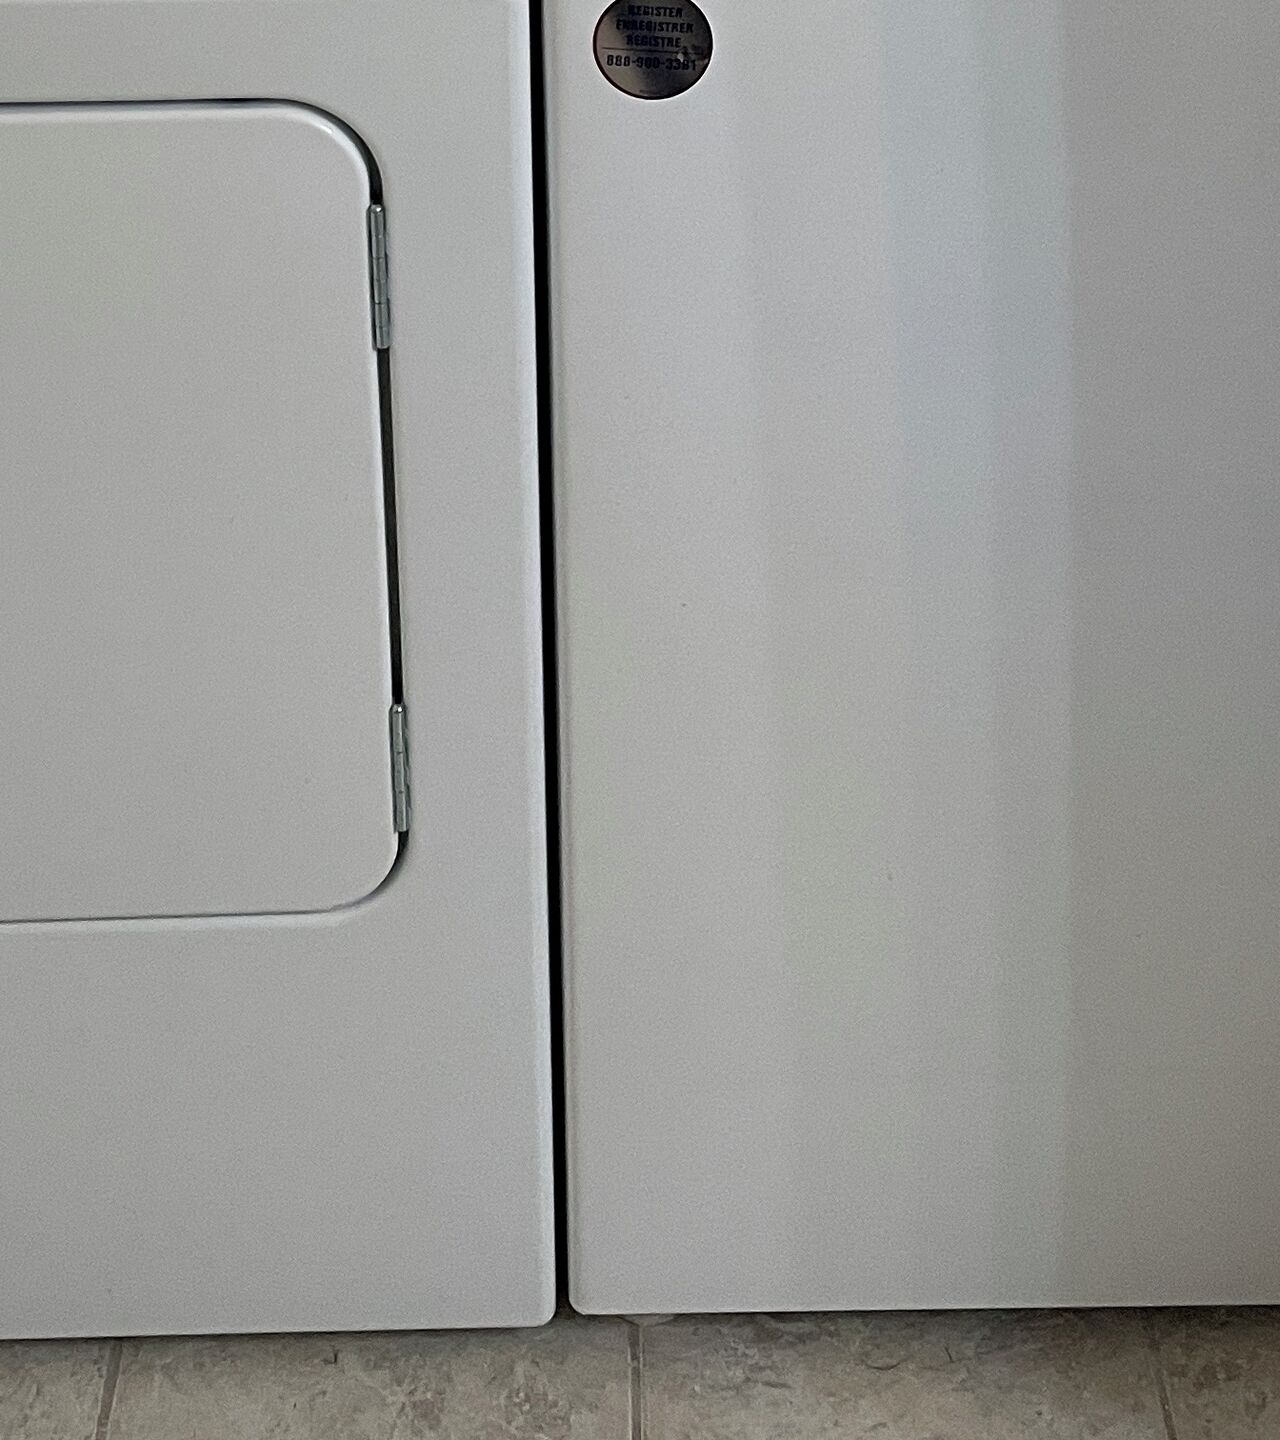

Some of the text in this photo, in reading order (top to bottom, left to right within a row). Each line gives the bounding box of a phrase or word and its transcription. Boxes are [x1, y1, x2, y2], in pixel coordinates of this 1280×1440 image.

[628, 5, 684, 18] REGISTER
[615, 18, 694, 33] ENREGISTRER
[626, 34, 682, 48] REGISTRE
[606, 54, 697, 71] 888-900-3381
